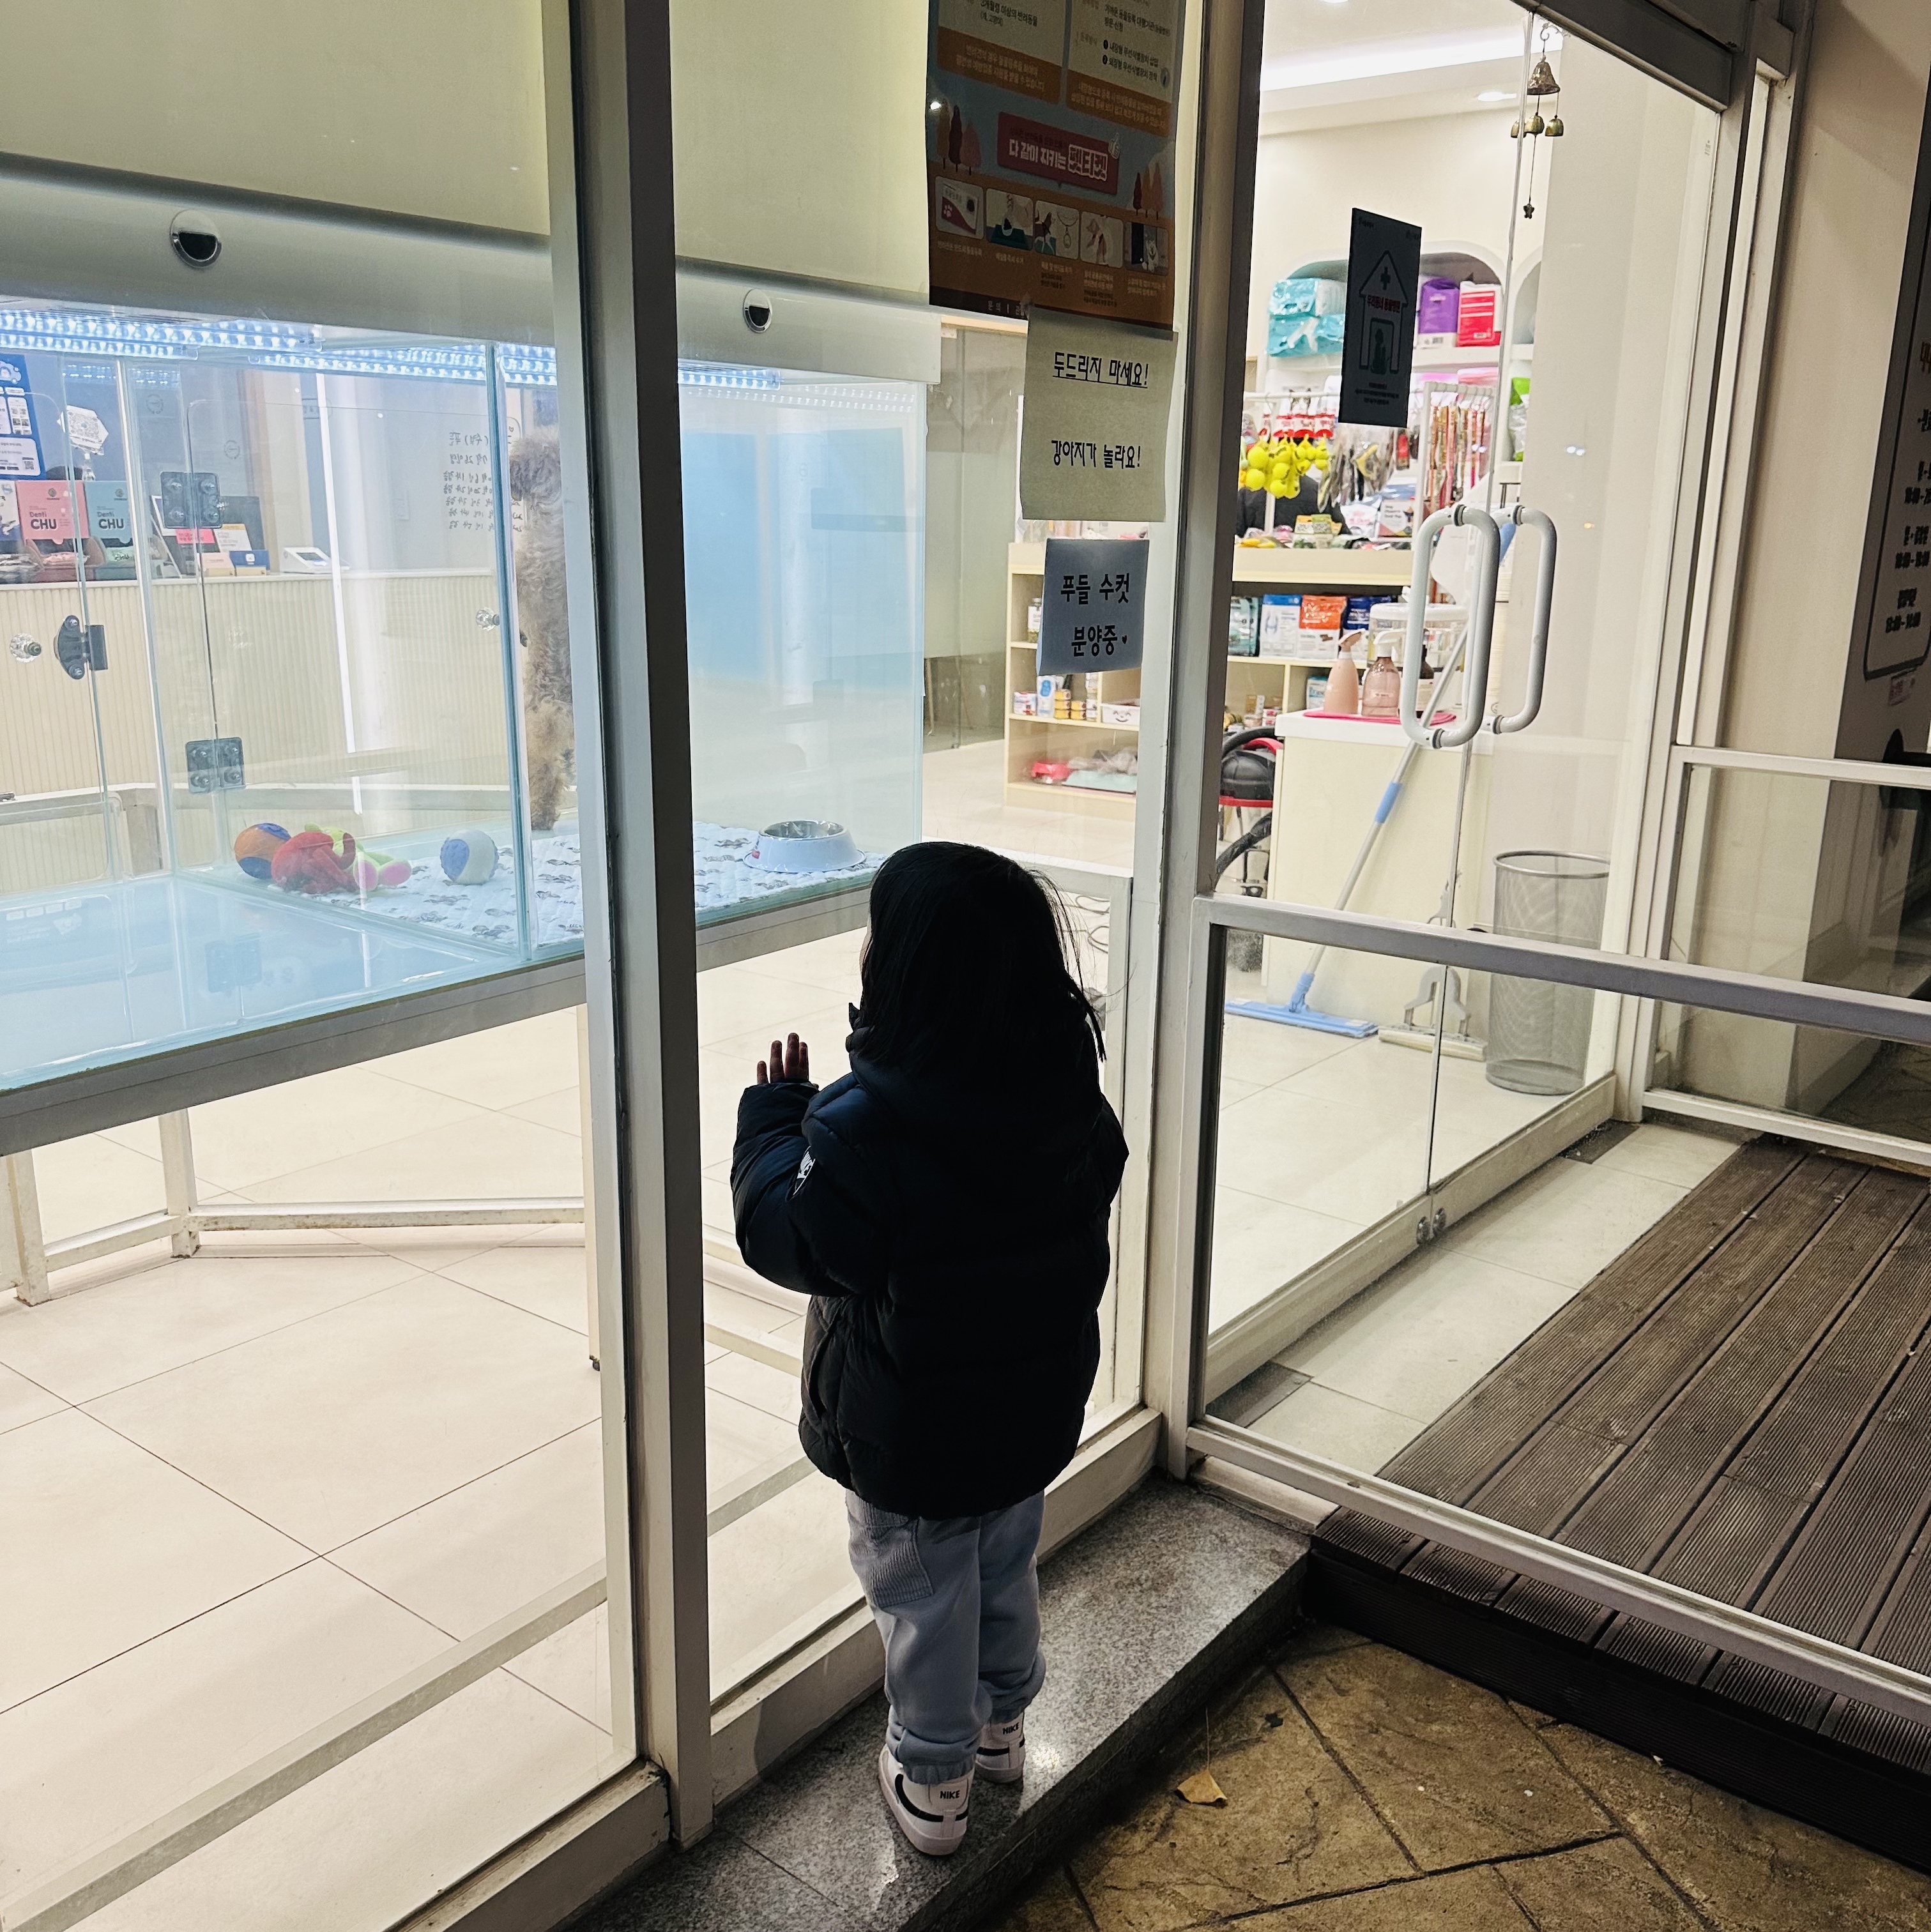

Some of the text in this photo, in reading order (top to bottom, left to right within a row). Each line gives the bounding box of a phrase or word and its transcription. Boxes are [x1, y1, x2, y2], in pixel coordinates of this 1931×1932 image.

[1009, 139, 1108, 181] 다 같이 지키는 펫티켓
[1054, 351, 1149, 386] 두드리지 마세요!
[1051, 439, 1141, 469] 강아지가 놀라요!
[31, 519, 57, 529] CHU
[98, 519, 125, 529] CHU
[1061, 573, 1129, 605] 푸들 수컷
[1071, 625, 1118, 657] 분양중
[1002, 1722, 1019, 1735] NIKE
[940, 1790, 960, 1799] NIKE
